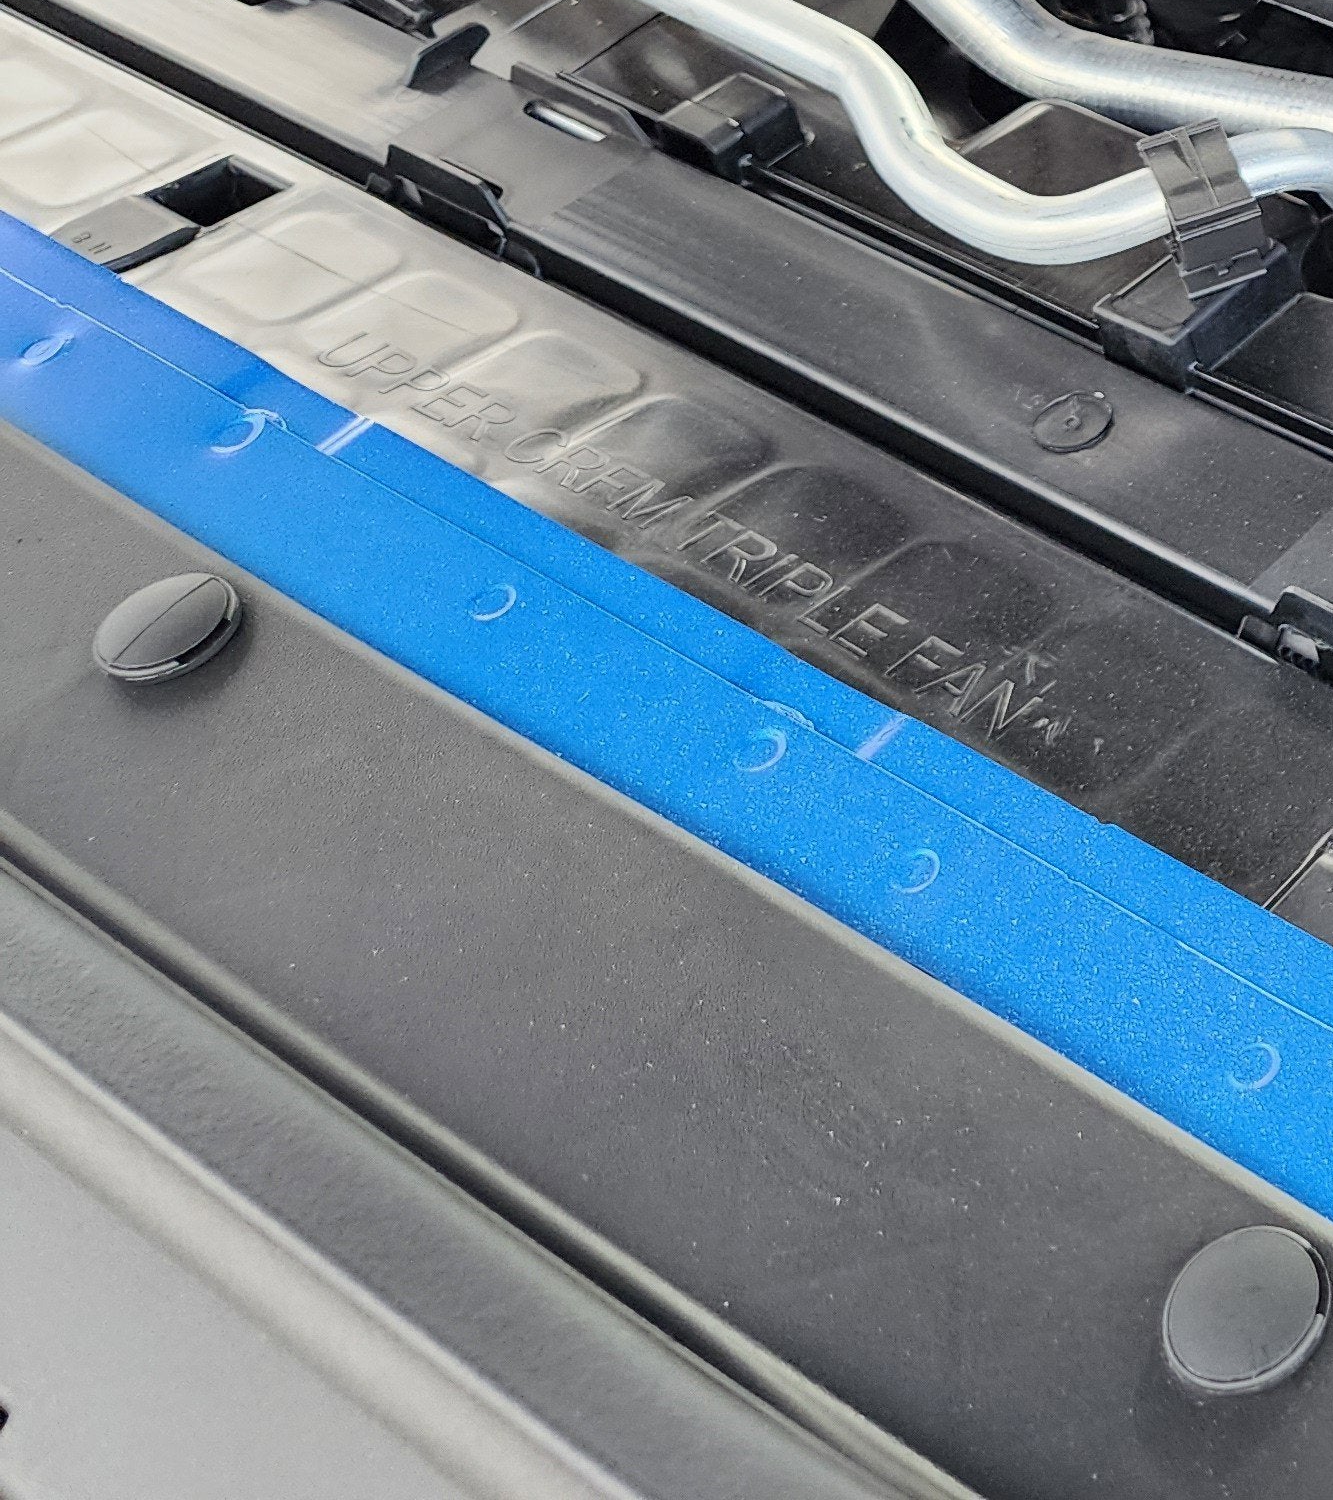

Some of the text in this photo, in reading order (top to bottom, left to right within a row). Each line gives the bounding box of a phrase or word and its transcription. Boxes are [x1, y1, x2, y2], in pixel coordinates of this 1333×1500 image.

[318, 331, 1046, 741] UPPER CRFM TRIPLE FAN
